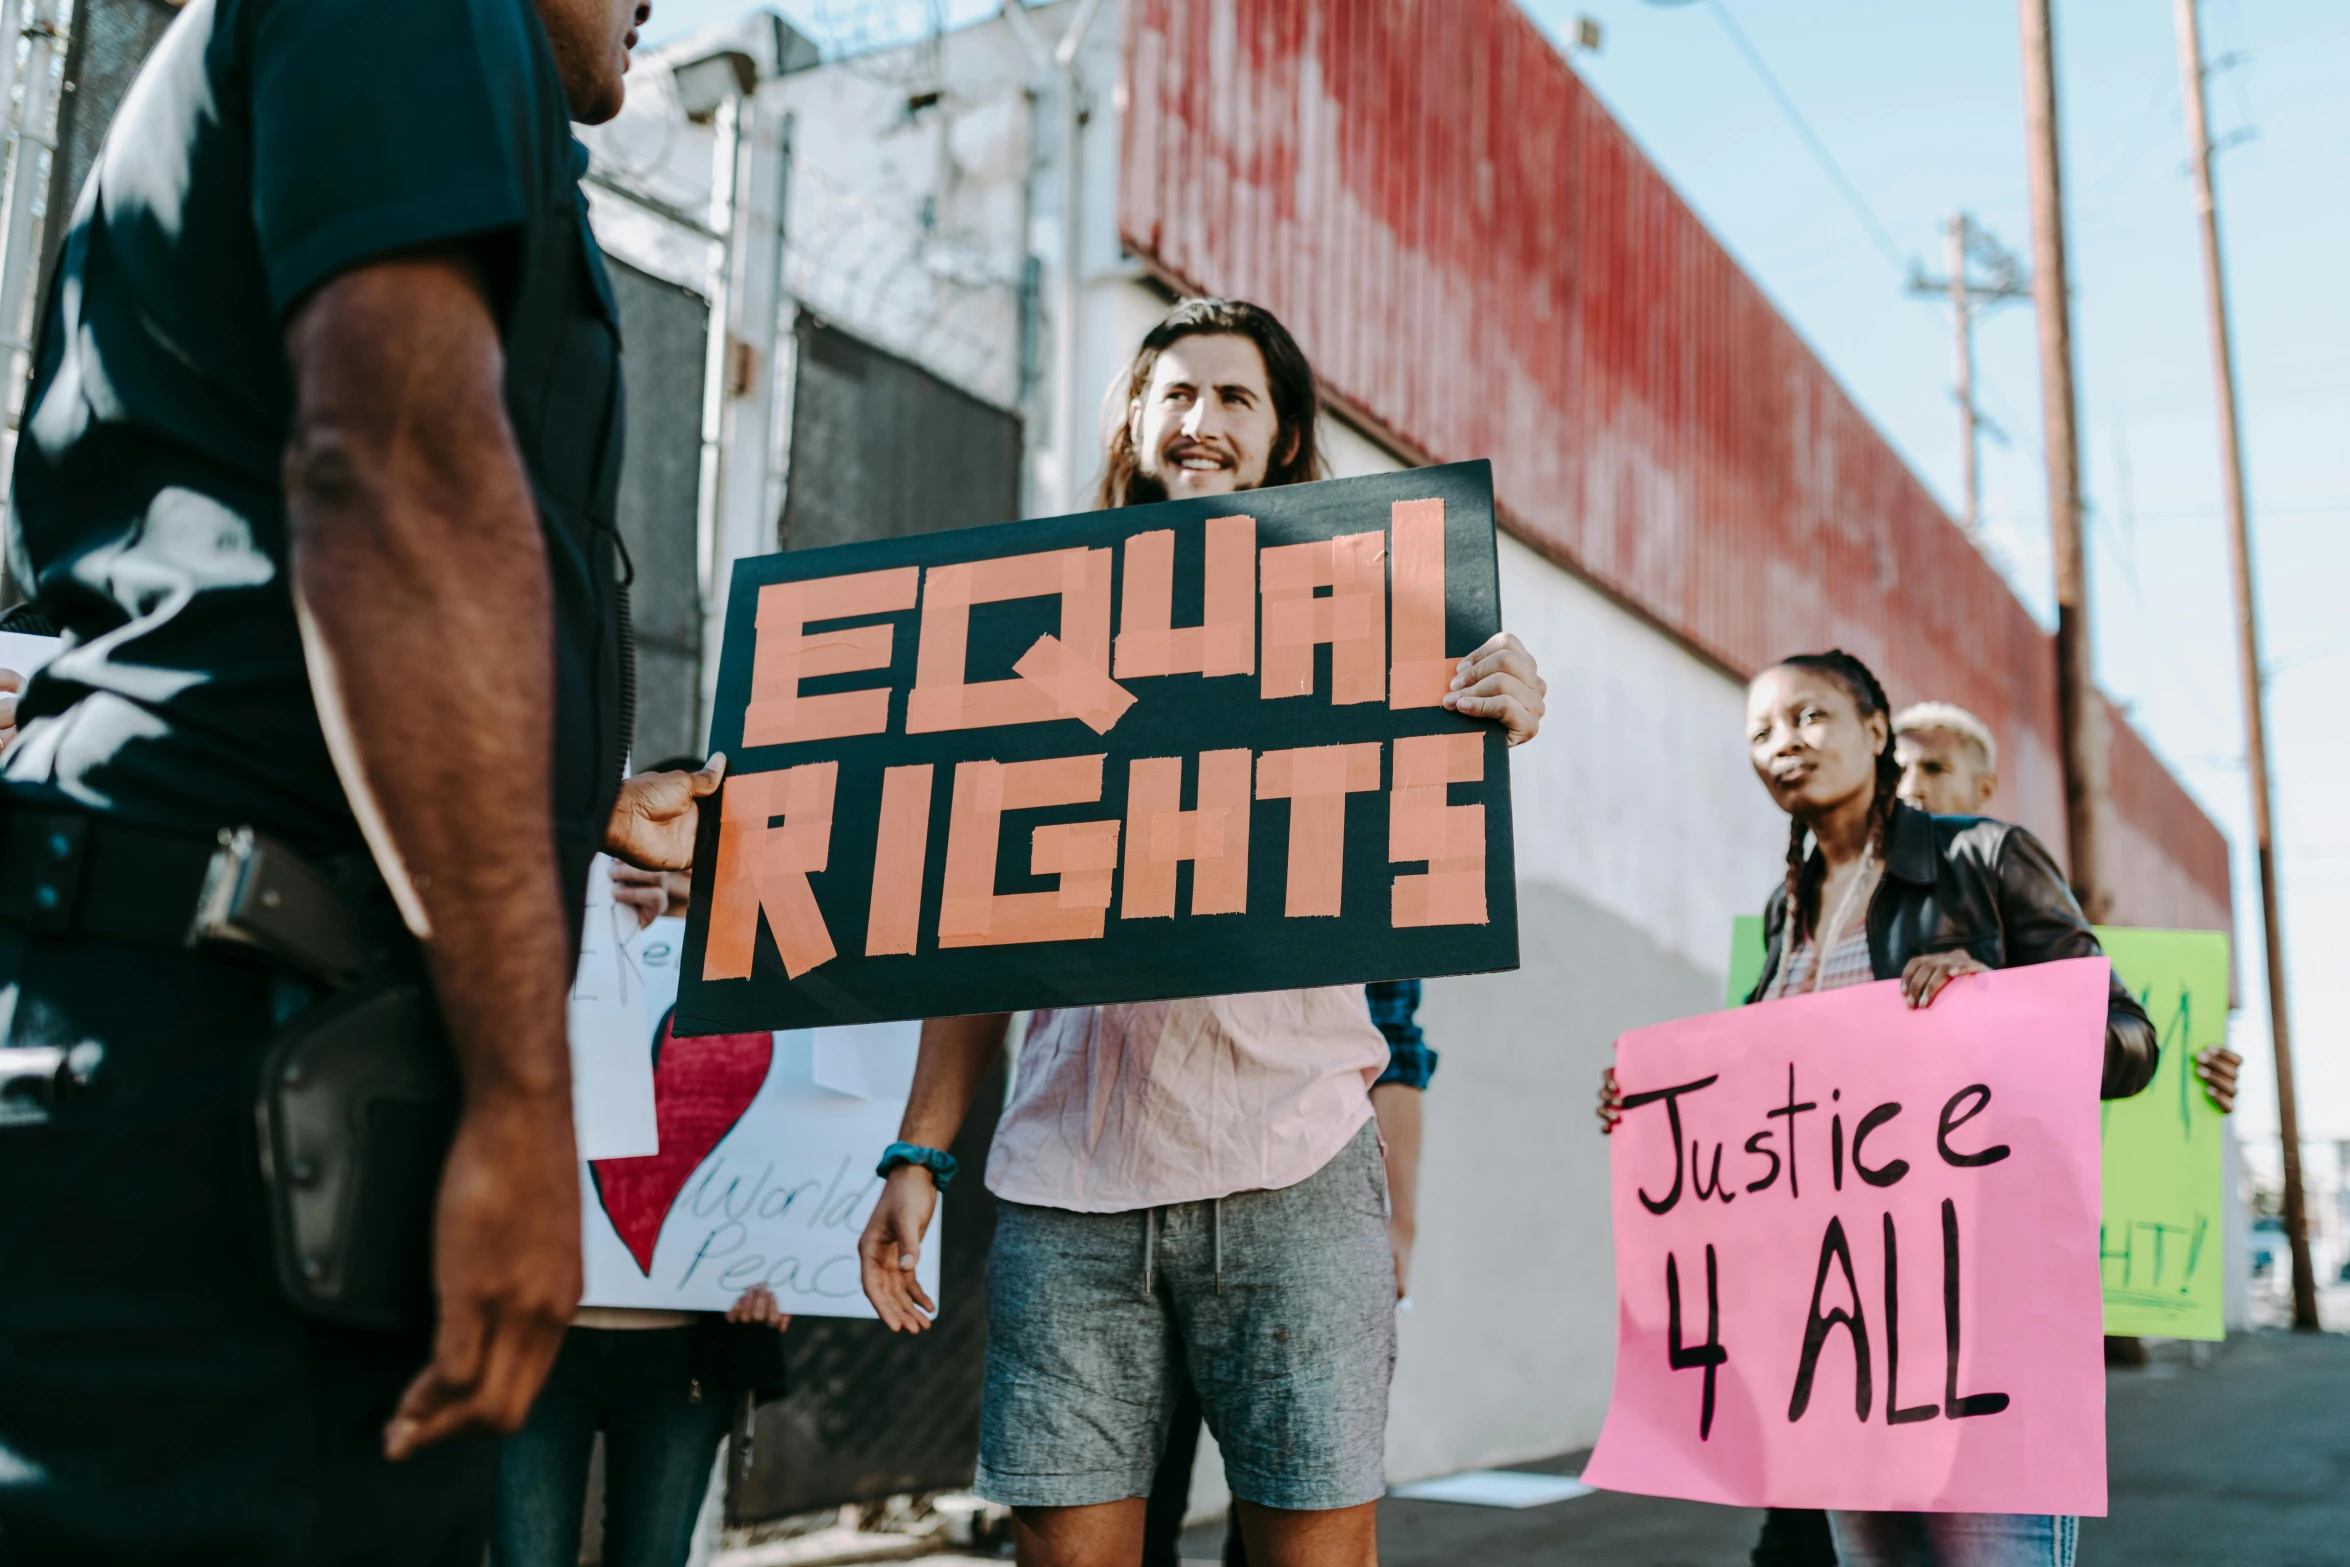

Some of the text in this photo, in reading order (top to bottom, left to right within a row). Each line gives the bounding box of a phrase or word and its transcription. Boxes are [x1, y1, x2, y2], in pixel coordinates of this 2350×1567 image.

[743, 497, 1465, 748] EQUAL
[703, 732, 1489, 981] RIGHTS
[678, 1152, 878, 1235] World
[1621, 1061, 2011, 1215] Justice
[677, 1220, 862, 1298] Peac
[1667, 1197, 2011, 1441] 4 ALL
[2100, 1211, 2208, 1295] HT!
